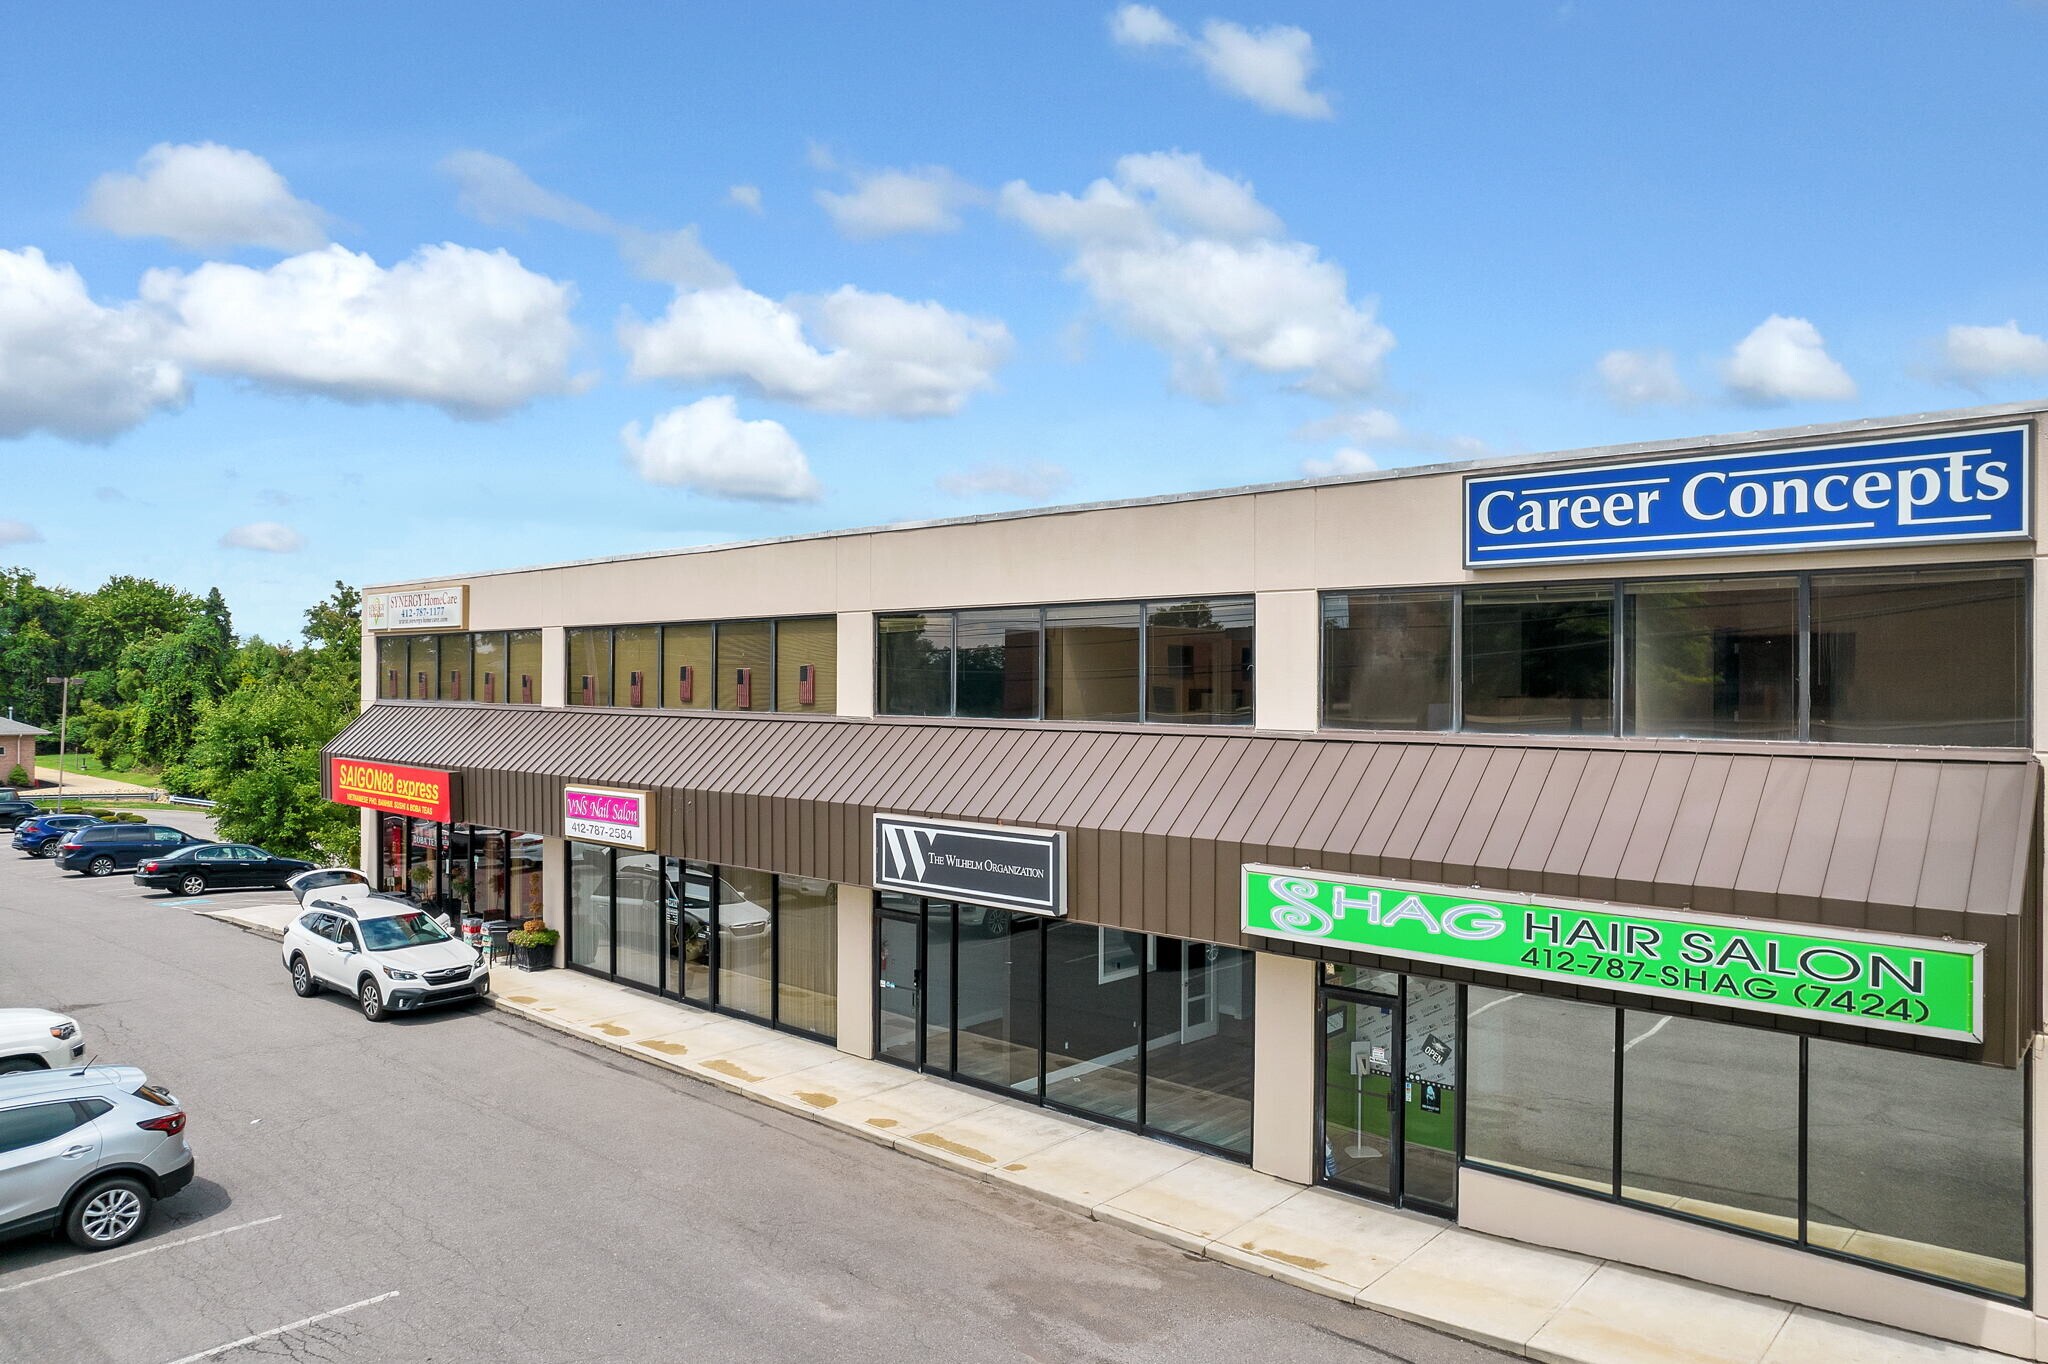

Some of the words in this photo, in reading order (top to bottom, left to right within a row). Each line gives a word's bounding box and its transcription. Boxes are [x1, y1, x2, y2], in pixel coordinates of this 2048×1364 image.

[1477, 489, 1660, 535] Career
[1681, 454, 2010, 526] Concepts
[390, 594, 423, 608] SYNERGY
[424, 592, 458, 606] HomeCare
[400, 606, 445, 618] 412-787-1177
[339, 764, 394, 793] SAIGON88
[396, 778, 439, 801] express
[421, 805, 433, 815] TEAS
[567, 795, 588, 816] VNS
[589, 797, 612, 818] Nail
[612, 801, 638, 822] Salon
[571, 822, 633, 841] 412-787-2584
[928, 852, 945, 865] THE
[945, 854, 983, 871] WILHELM
[984, 859, 1045, 879] ORGANIZATION
[1268, 875, 1506, 941] SHAG
[1523, 911, 1661, 959] HAIR
[1681, 932, 1924, 995] SALON
[1520, 947, 1778, 1000] 412-787-SHAG
[1794, 983, 1930, 1024] (7424)
[1424, 1046, 1444, 1064] OPEN
